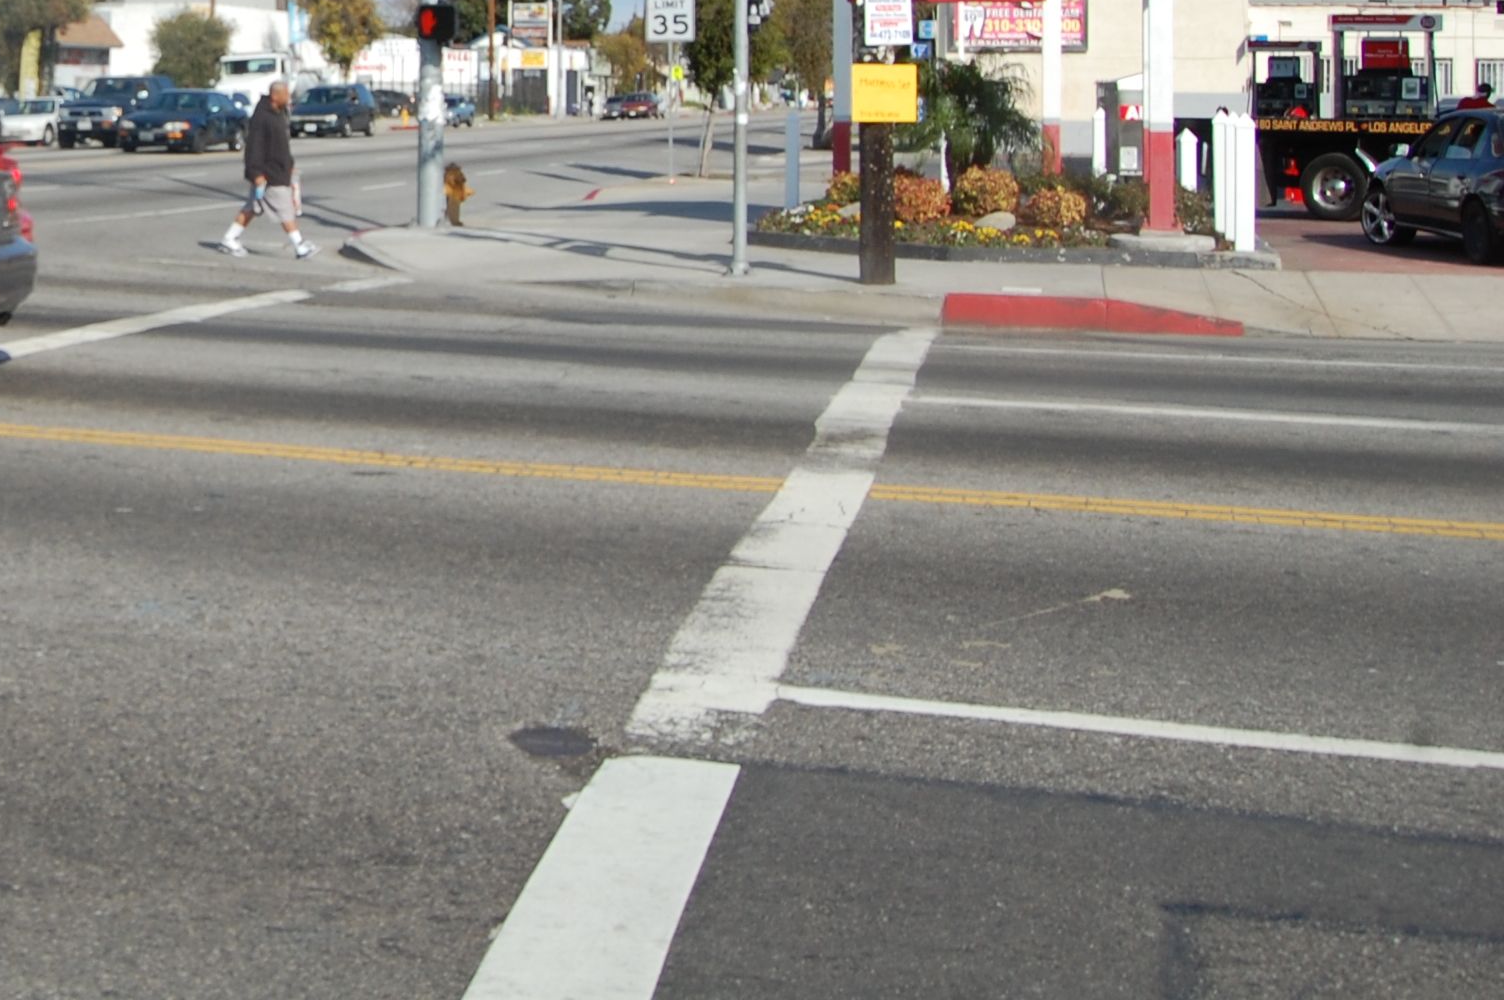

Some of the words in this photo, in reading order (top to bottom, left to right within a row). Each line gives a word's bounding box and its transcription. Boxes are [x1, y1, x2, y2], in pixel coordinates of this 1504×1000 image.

[654, 0, 686, 9] LIMIT
[986, 7, 1010, 18] FREE
[1012, 7, 1043, 18] DENTA
[652, 14, 689, 35] 35
[1272, 119, 1298, 130] SAINT
[1299, 119, 1345, 132] ANDREWS
[1368, 121, 1387, 133] LOS
